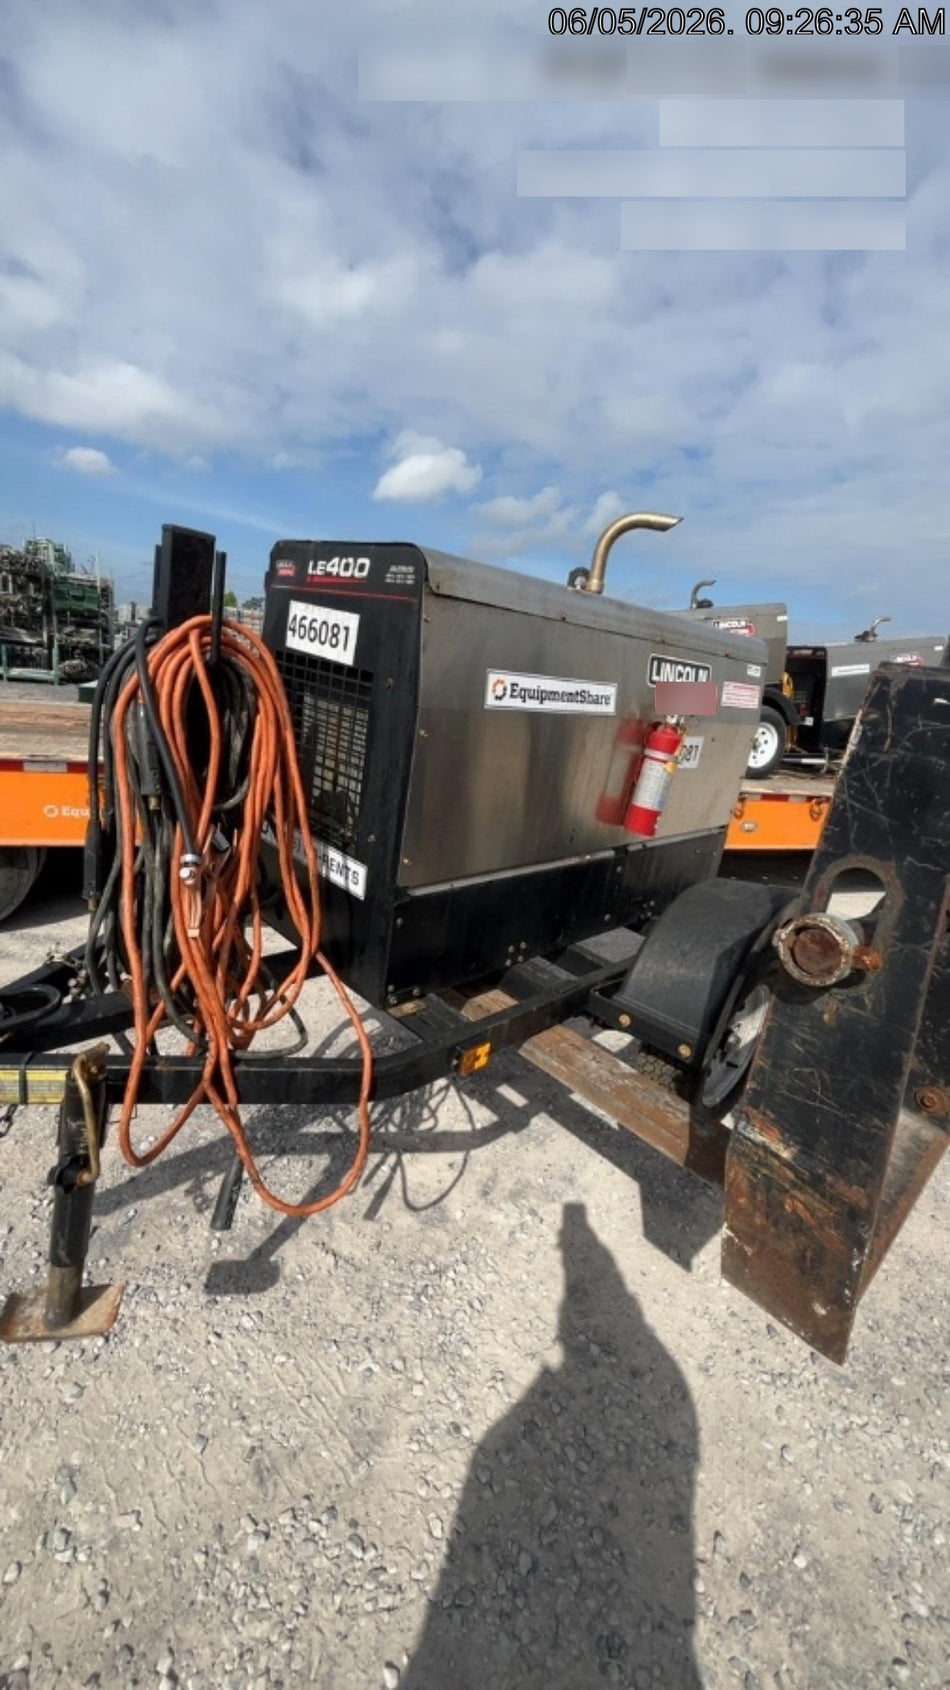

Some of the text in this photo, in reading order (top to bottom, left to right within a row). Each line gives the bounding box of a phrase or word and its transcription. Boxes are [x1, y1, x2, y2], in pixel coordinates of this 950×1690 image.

[307, 557, 371, 578] LE400
[288, 613, 351, 653] 466081
[651, 660, 710, 682] LINCOLN
[509, 683, 612, 706] EquipmentShare
[680, 744, 700, 762] 081
